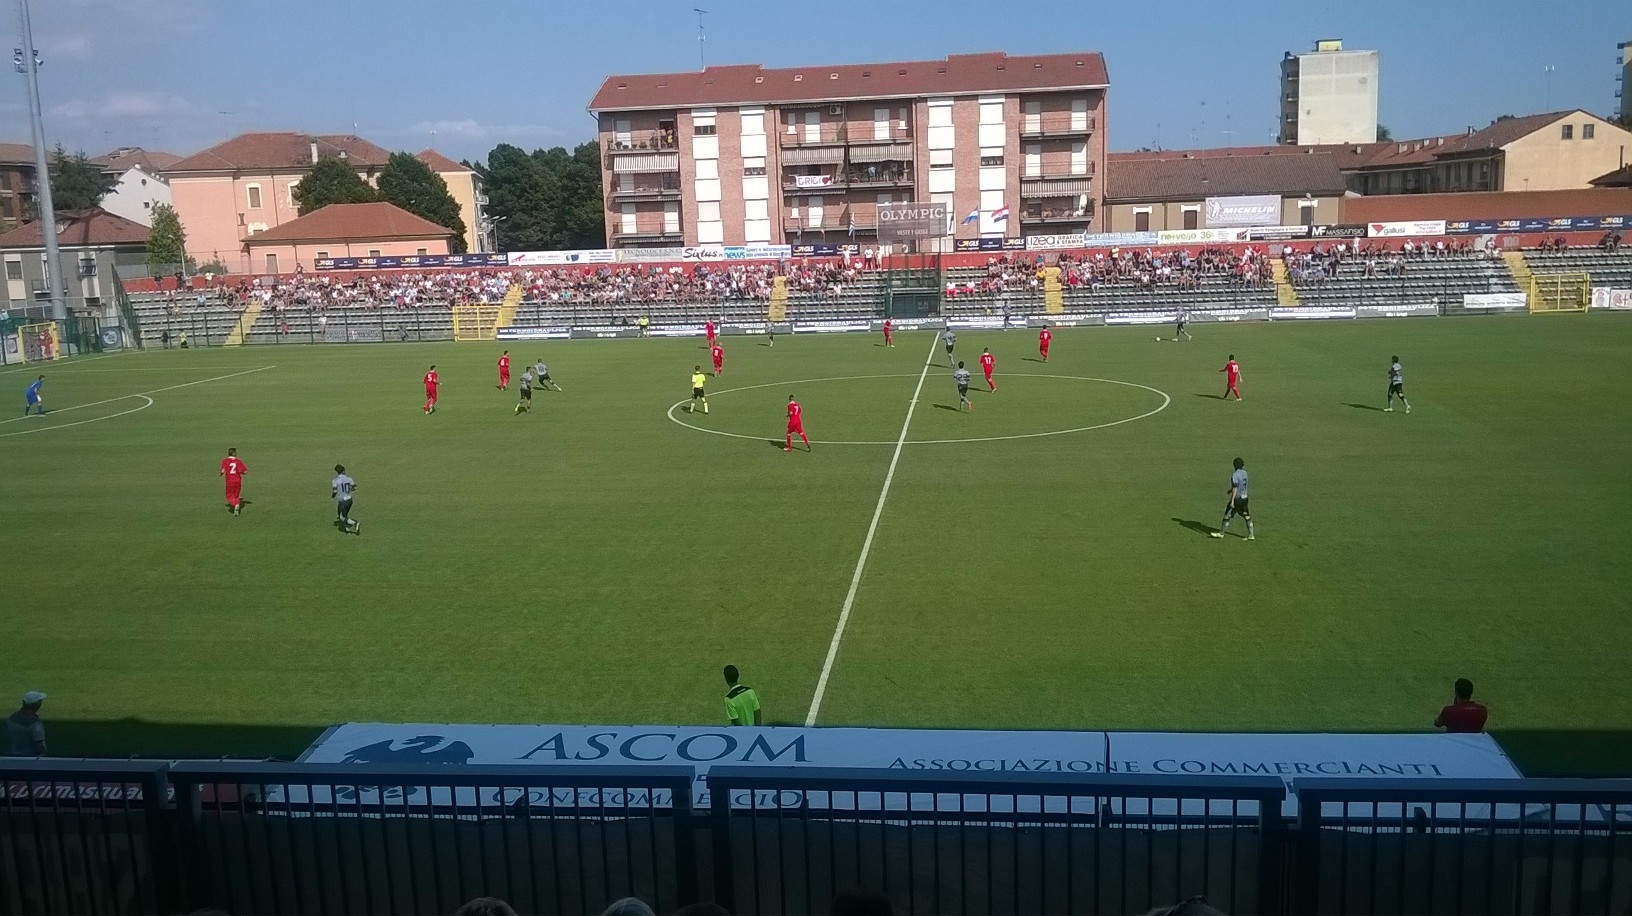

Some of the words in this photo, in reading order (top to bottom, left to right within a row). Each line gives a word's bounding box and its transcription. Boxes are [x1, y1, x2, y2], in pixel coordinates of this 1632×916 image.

[798, 177, 821, 186] GRIGI
[881, 207, 944, 221] OLYMPIC
[1223, 205, 1275, 214] MICHELIN
[1312, 226, 1326, 237] MF
[724, 250, 746, 259] news
[428, 374, 432, 382] 5
[794, 405, 799, 415] 7
[229, 462, 237, 474] 2
[341, 482, 351, 494] 10
[513, 732, 813, 762] ASCOM
[1152, 759, 1444, 776] COMMERCIANTI
